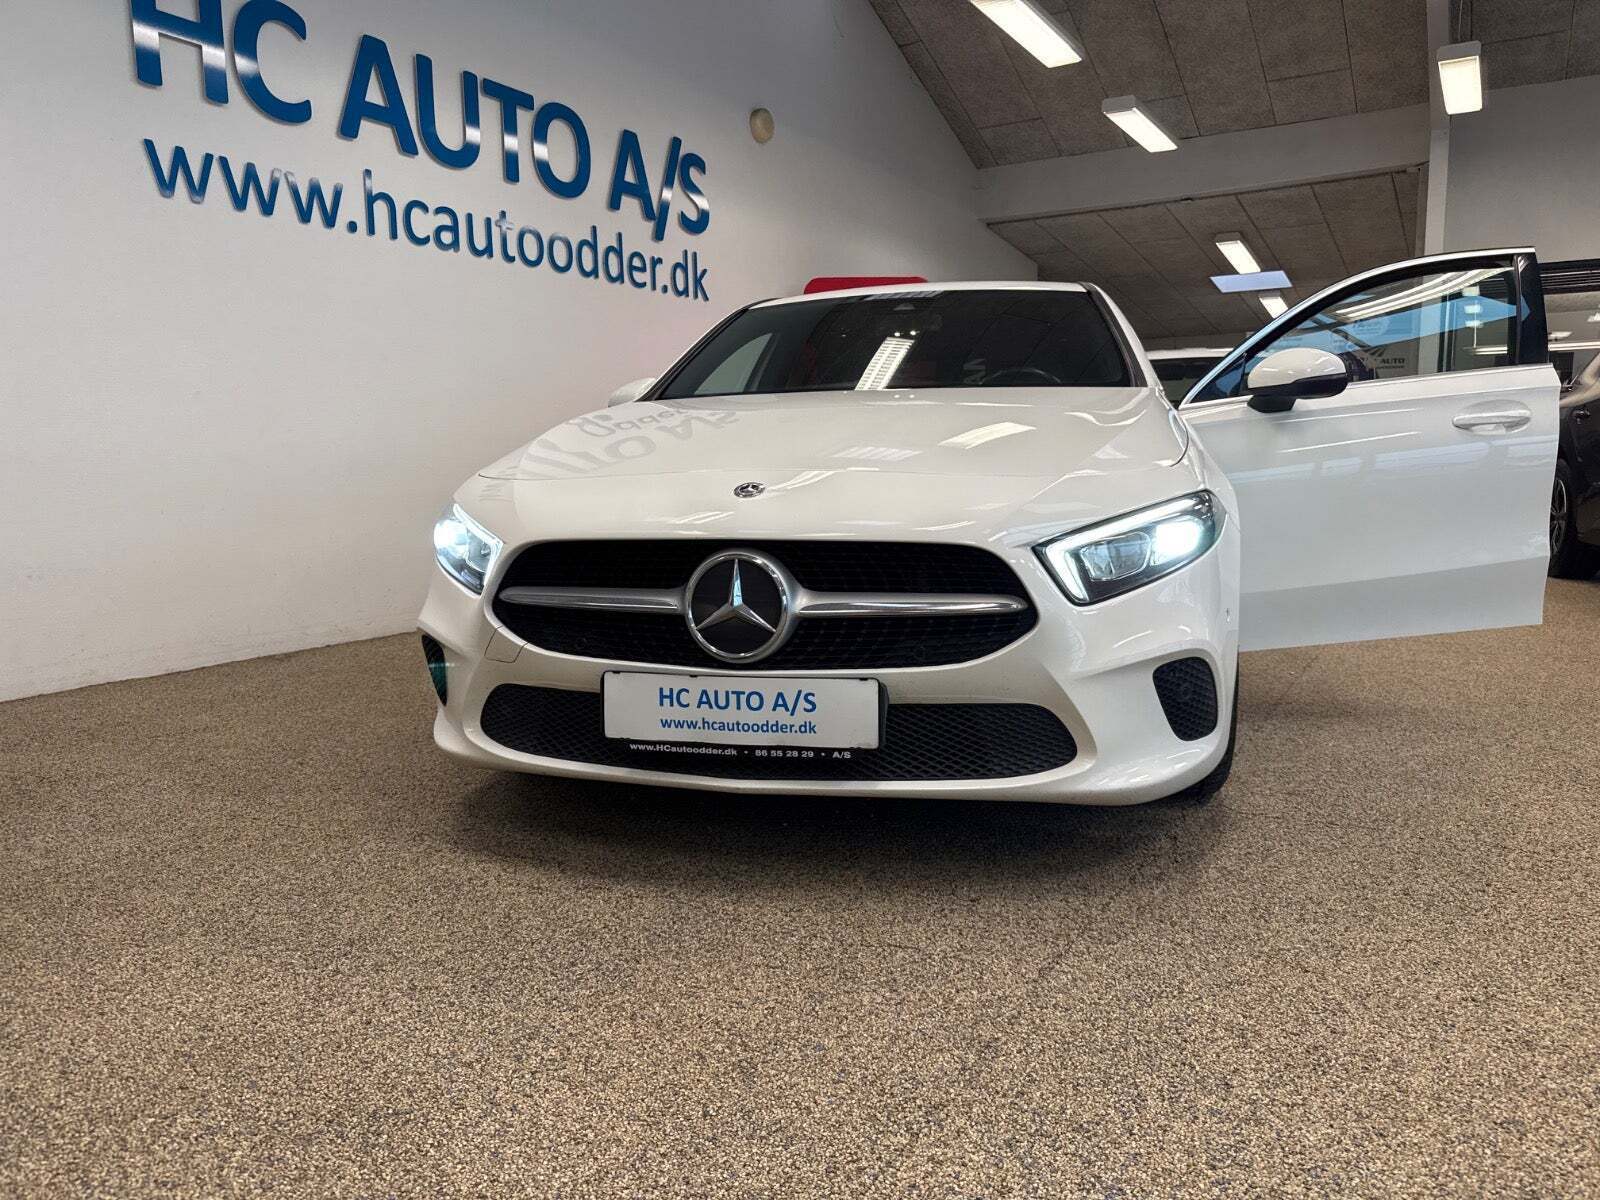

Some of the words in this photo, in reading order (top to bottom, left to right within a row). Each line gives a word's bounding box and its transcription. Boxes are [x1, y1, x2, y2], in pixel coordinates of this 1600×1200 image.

[130, 0, 313, 125] HC
[338, 34, 592, 200] AUTO
[608, 128, 711, 242] A/S
[143, 137, 709, 302] www.hcautoodder.dk
[659, 687, 690, 708] HC
[696, 689, 764, 711] AUTO
[772, 689, 817, 716] A/S
[660, 717, 817, 734] www.hcautoodder.dk
[832, 751, 851, 760] A/S
